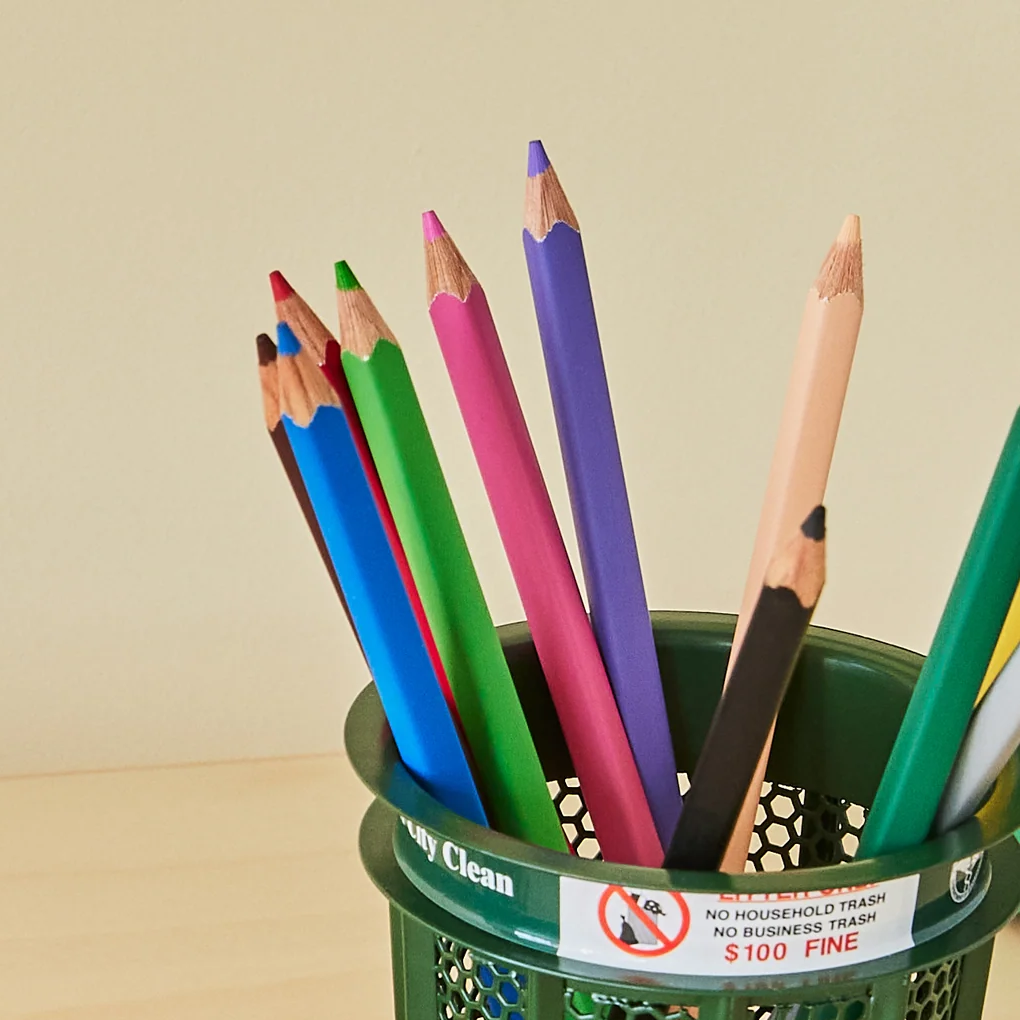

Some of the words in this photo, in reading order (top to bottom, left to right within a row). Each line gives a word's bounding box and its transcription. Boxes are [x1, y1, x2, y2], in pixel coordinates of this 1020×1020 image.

[442, 841, 515, 897] Clean
[705, 908, 730, 921] NO
[735, 903, 834, 921] HOUSEHOLD
[839, 892, 886, 911] TRASH
[713, 926, 738, 938] NO
[743, 922, 822, 938] BUSINESS
[829, 911, 876, 930] TRASH
[724, 942, 788, 964] $100
[804, 931, 859, 957] FINE
